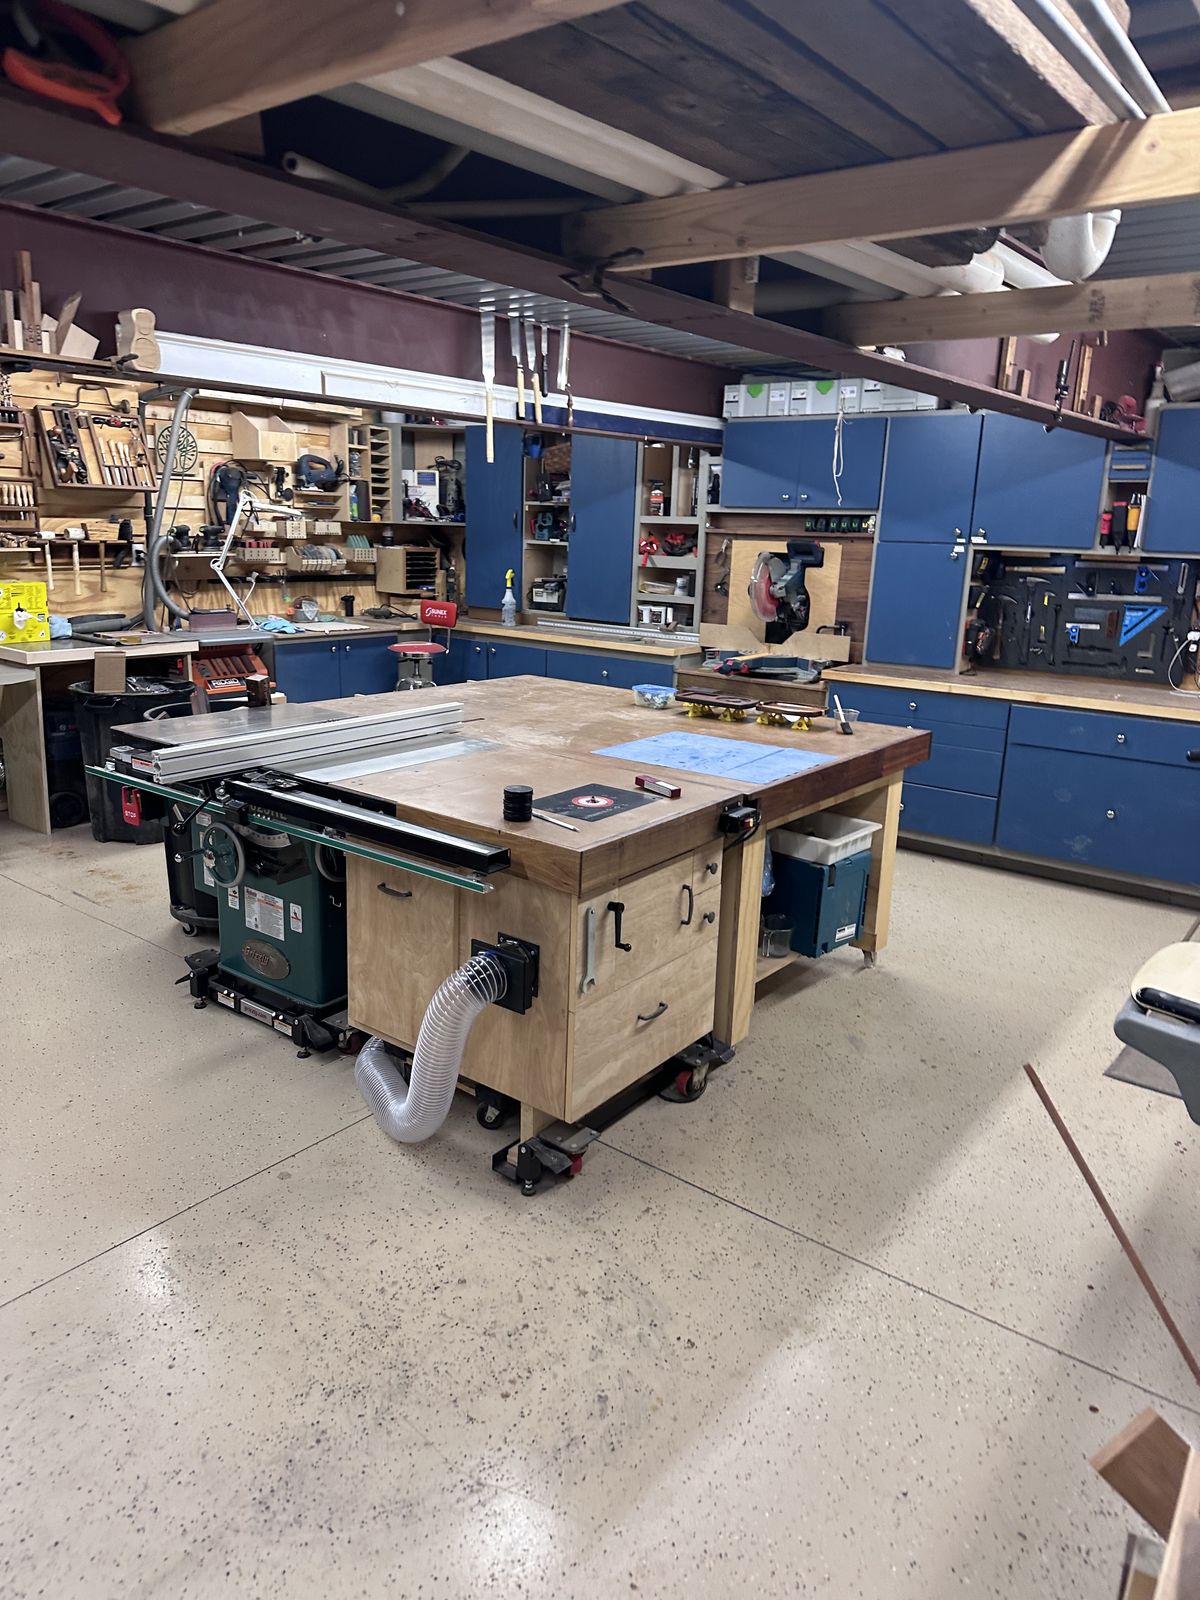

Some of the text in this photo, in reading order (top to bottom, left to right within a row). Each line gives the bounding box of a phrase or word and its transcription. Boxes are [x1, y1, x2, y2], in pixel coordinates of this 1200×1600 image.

[211, 678, 239, 686] RIDGID
[124, 810, 137, 818] STOP
[242, 945, 270, 966] Grizzly
